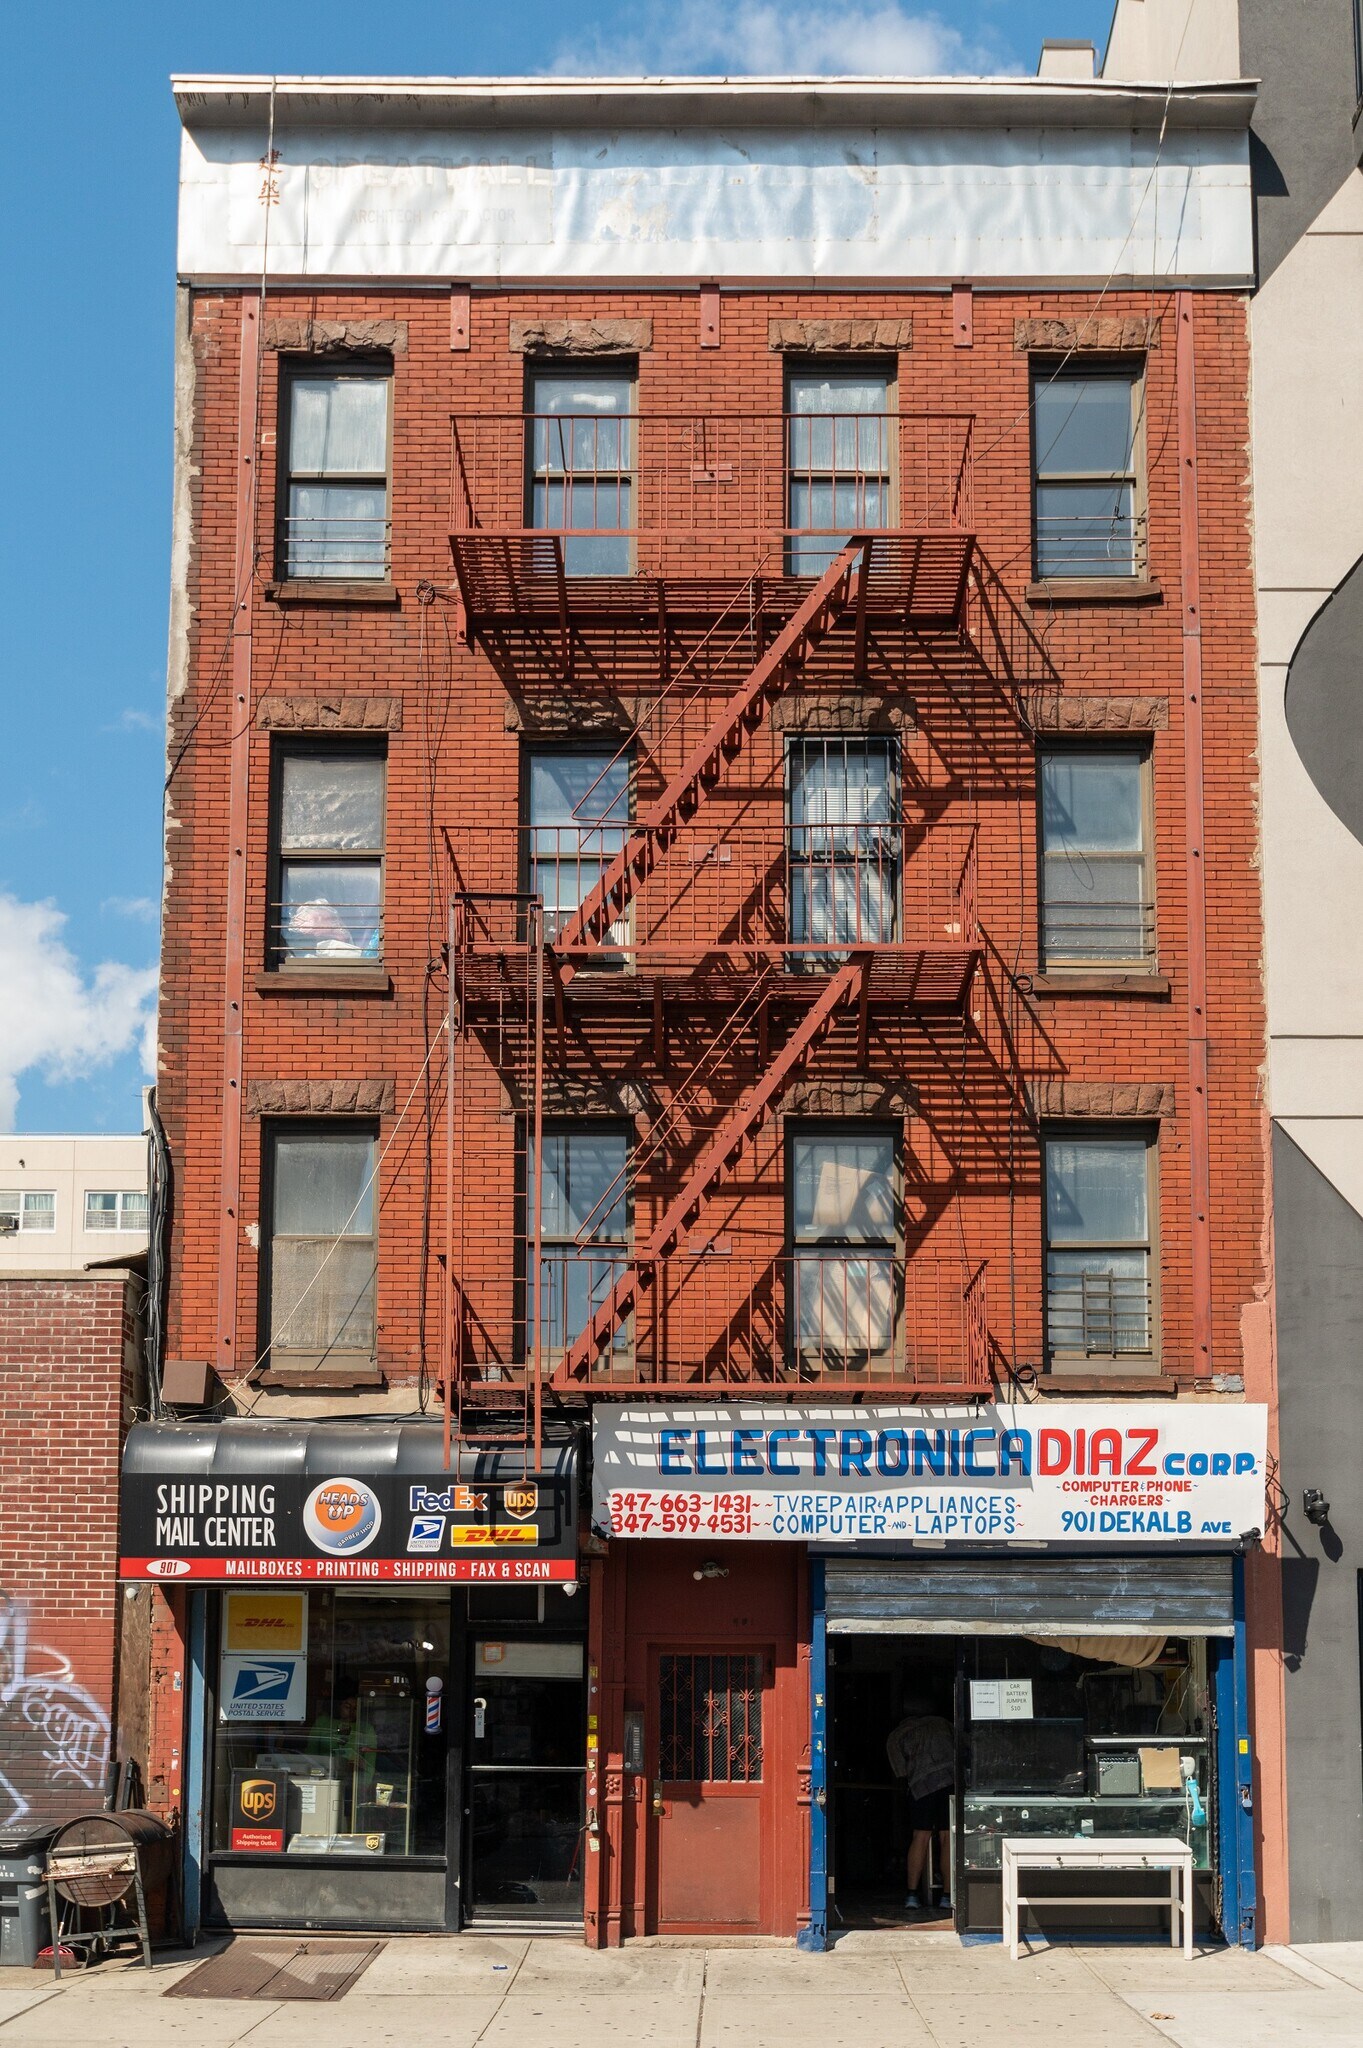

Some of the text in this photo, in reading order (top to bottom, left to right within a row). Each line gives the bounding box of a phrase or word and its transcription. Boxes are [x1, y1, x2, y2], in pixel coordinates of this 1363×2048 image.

[659, 1428, 1258, 1477] ELECTRONICA DIAZ CORP.
[1062, 1480, 1139, 1492] COMPUTER
[1146, 1480, 1192, 1492] PHONE
[156, 1484, 275, 1514] SHIPPING
[319, 1491, 369, 1506] HEADS
[410, 1485, 488, 1511] FedEx
[507, 1491, 535, 1512] ups
[883, 1495, 1016, 1514] APPLIANCES
[1090, 1494, 1164, 1506] CHARGERS
[327, 1504, 355, 1520] UP
[1061, 1510, 1232, 1533] 901 DEKALB AVE
[156, 1517, 276, 1547] MAIL CENTER
[337, 1520, 374, 1547] BARBER SHOP
[773, 1515, 886, 1534] COMPUTER
[915, 1515, 1016, 1534] LAPTOPS
[464, 1529, 526, 1542] DHL
[159, 1560, 179, 1574] 901
[225, 1560, 551, 1578] MAILBOXES PRINTING SHIPPING FAX & SCAN
[244, 1618, 286, 1627] DHL
[244, 1792, 273, 1815] ups
